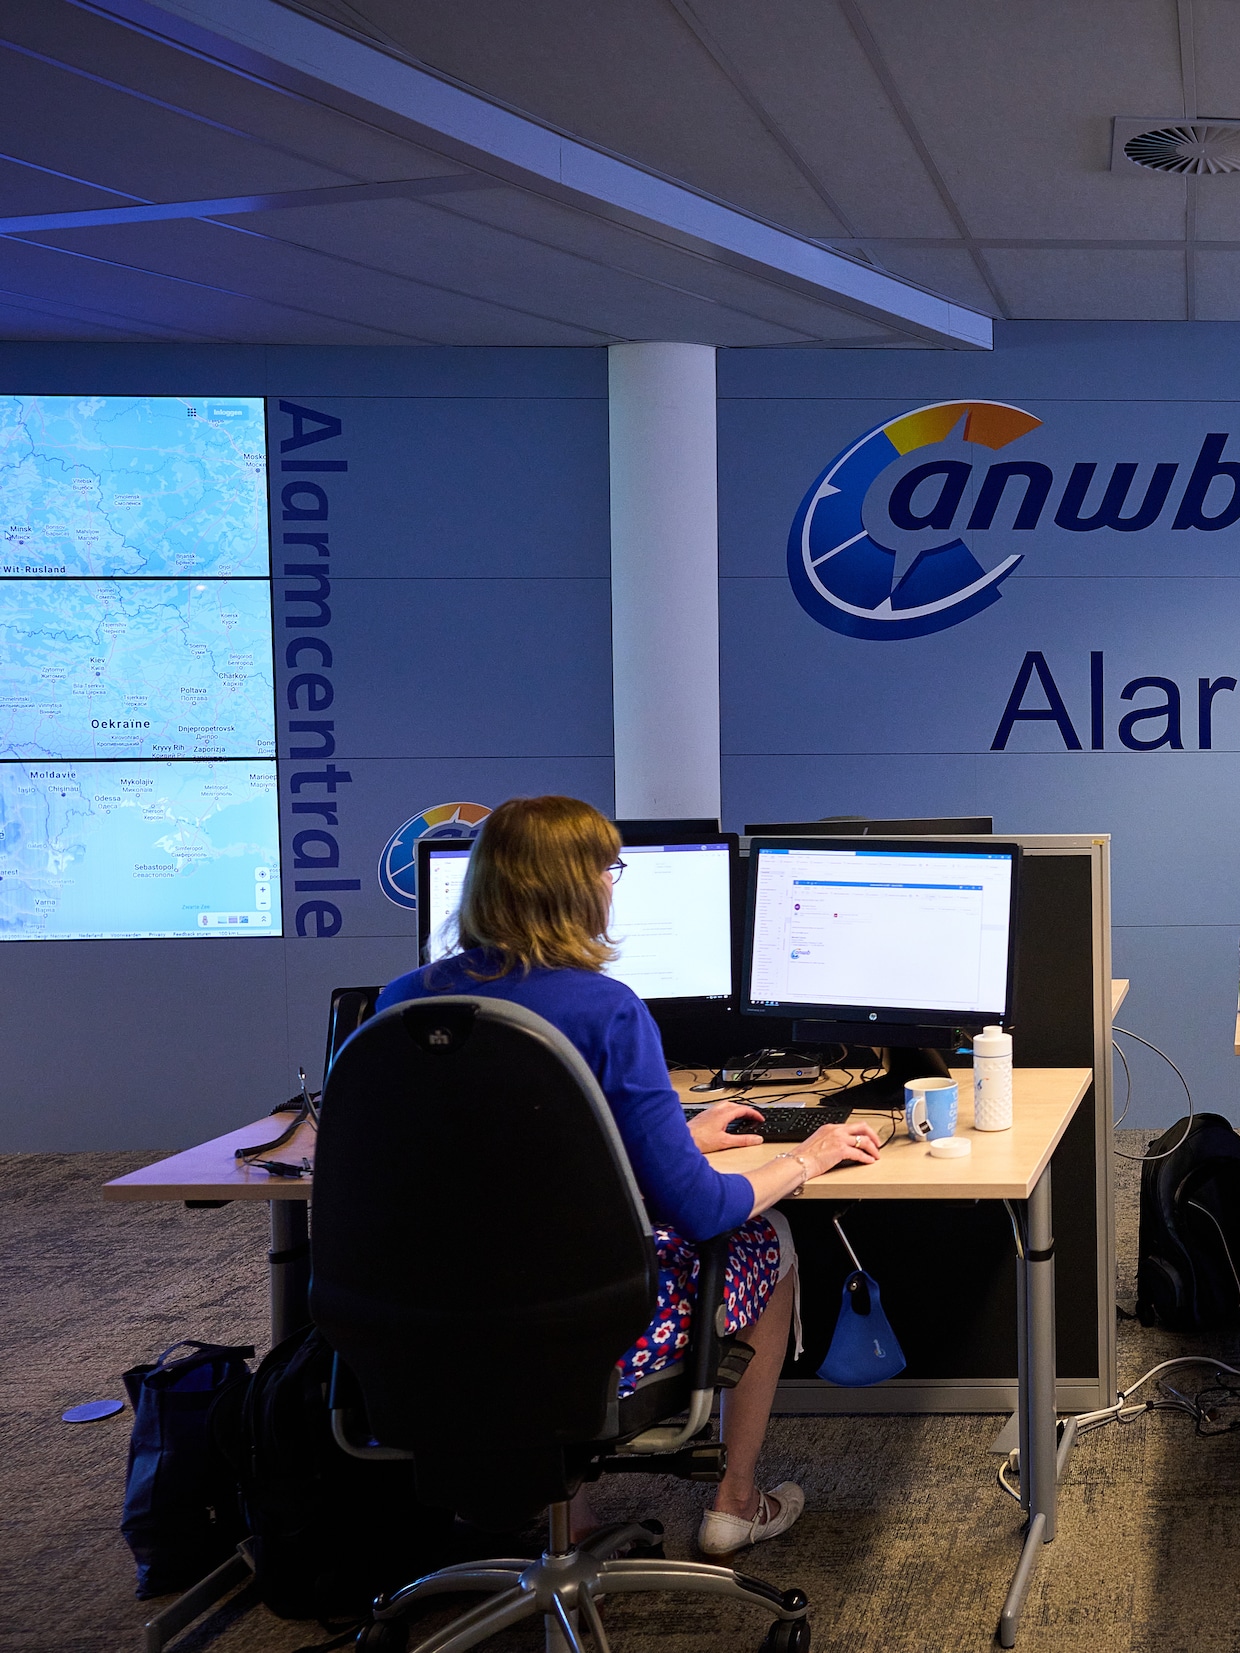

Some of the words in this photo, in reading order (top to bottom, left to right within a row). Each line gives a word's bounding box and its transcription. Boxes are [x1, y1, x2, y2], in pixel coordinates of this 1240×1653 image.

[213, 409, 243, 417] Inloggen
[3, 565, 66, 574] Wit-Rusland
[279, 400, 362, 937] Alarmcentrale
[218, 672, 248, 680] Charkov
[91, 718, 150, 729] Oekraïne
[178, 725, 235, 733] Dnjepropetrovsk
[152, 744, 171, 752] Kryvy
[30, 771, 76, 779] Moldavie
[120, 778, 154, 787] Mykolajiv
[134, 863, 174, 871] Sebastopol
